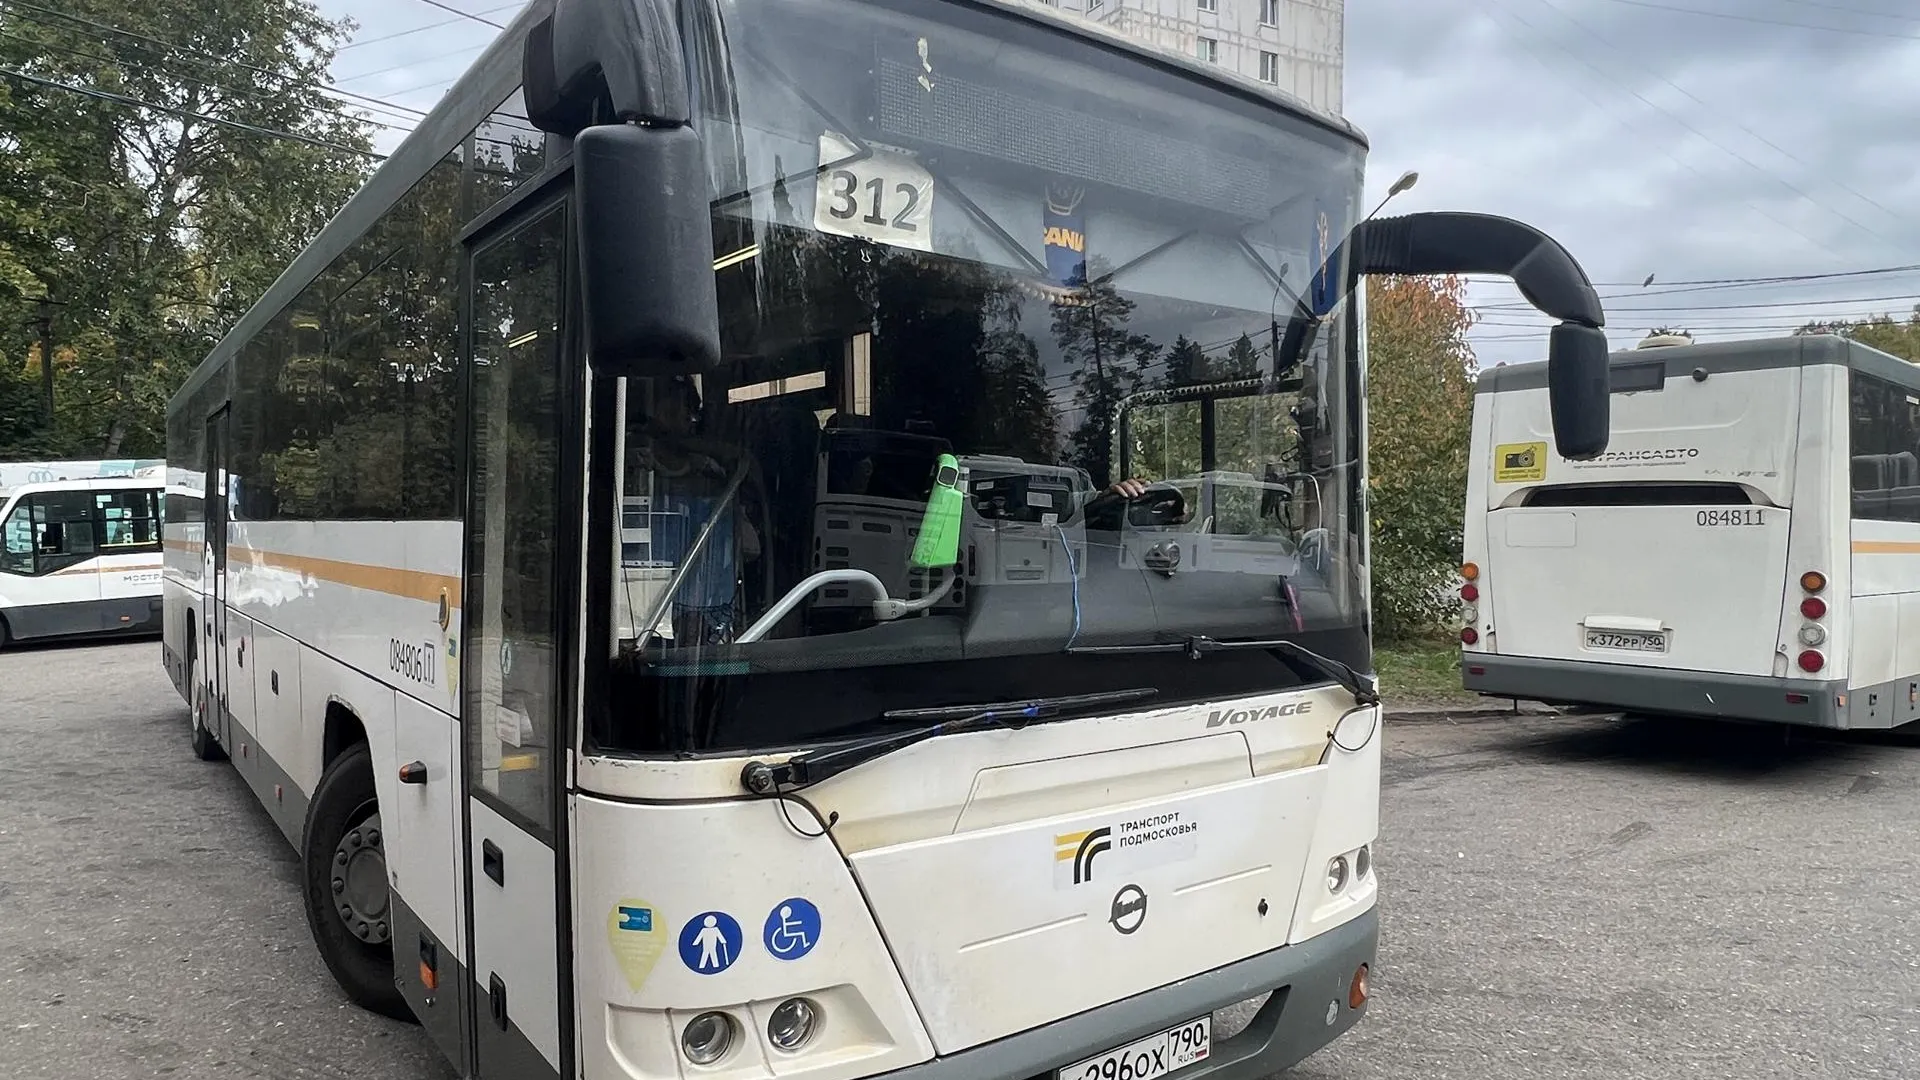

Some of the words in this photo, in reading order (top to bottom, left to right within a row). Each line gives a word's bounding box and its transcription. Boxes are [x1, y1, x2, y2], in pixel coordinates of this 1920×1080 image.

[829, 169, 919, 232] 312
[1697, 510, 1765, 526] 084811
[390, 638, 422, 683] 084806
[1120, 812, 1180, 833] ТРАНСПОРТ
[1120, 822, 1197, 848] ПОДМОСКОВЬЯ
[1078, 1045, 1165, 1080] 296ОХ
[1170, 1023, 1204, 1057] 790
[1178, 1052, 1194, 1064] RUS
